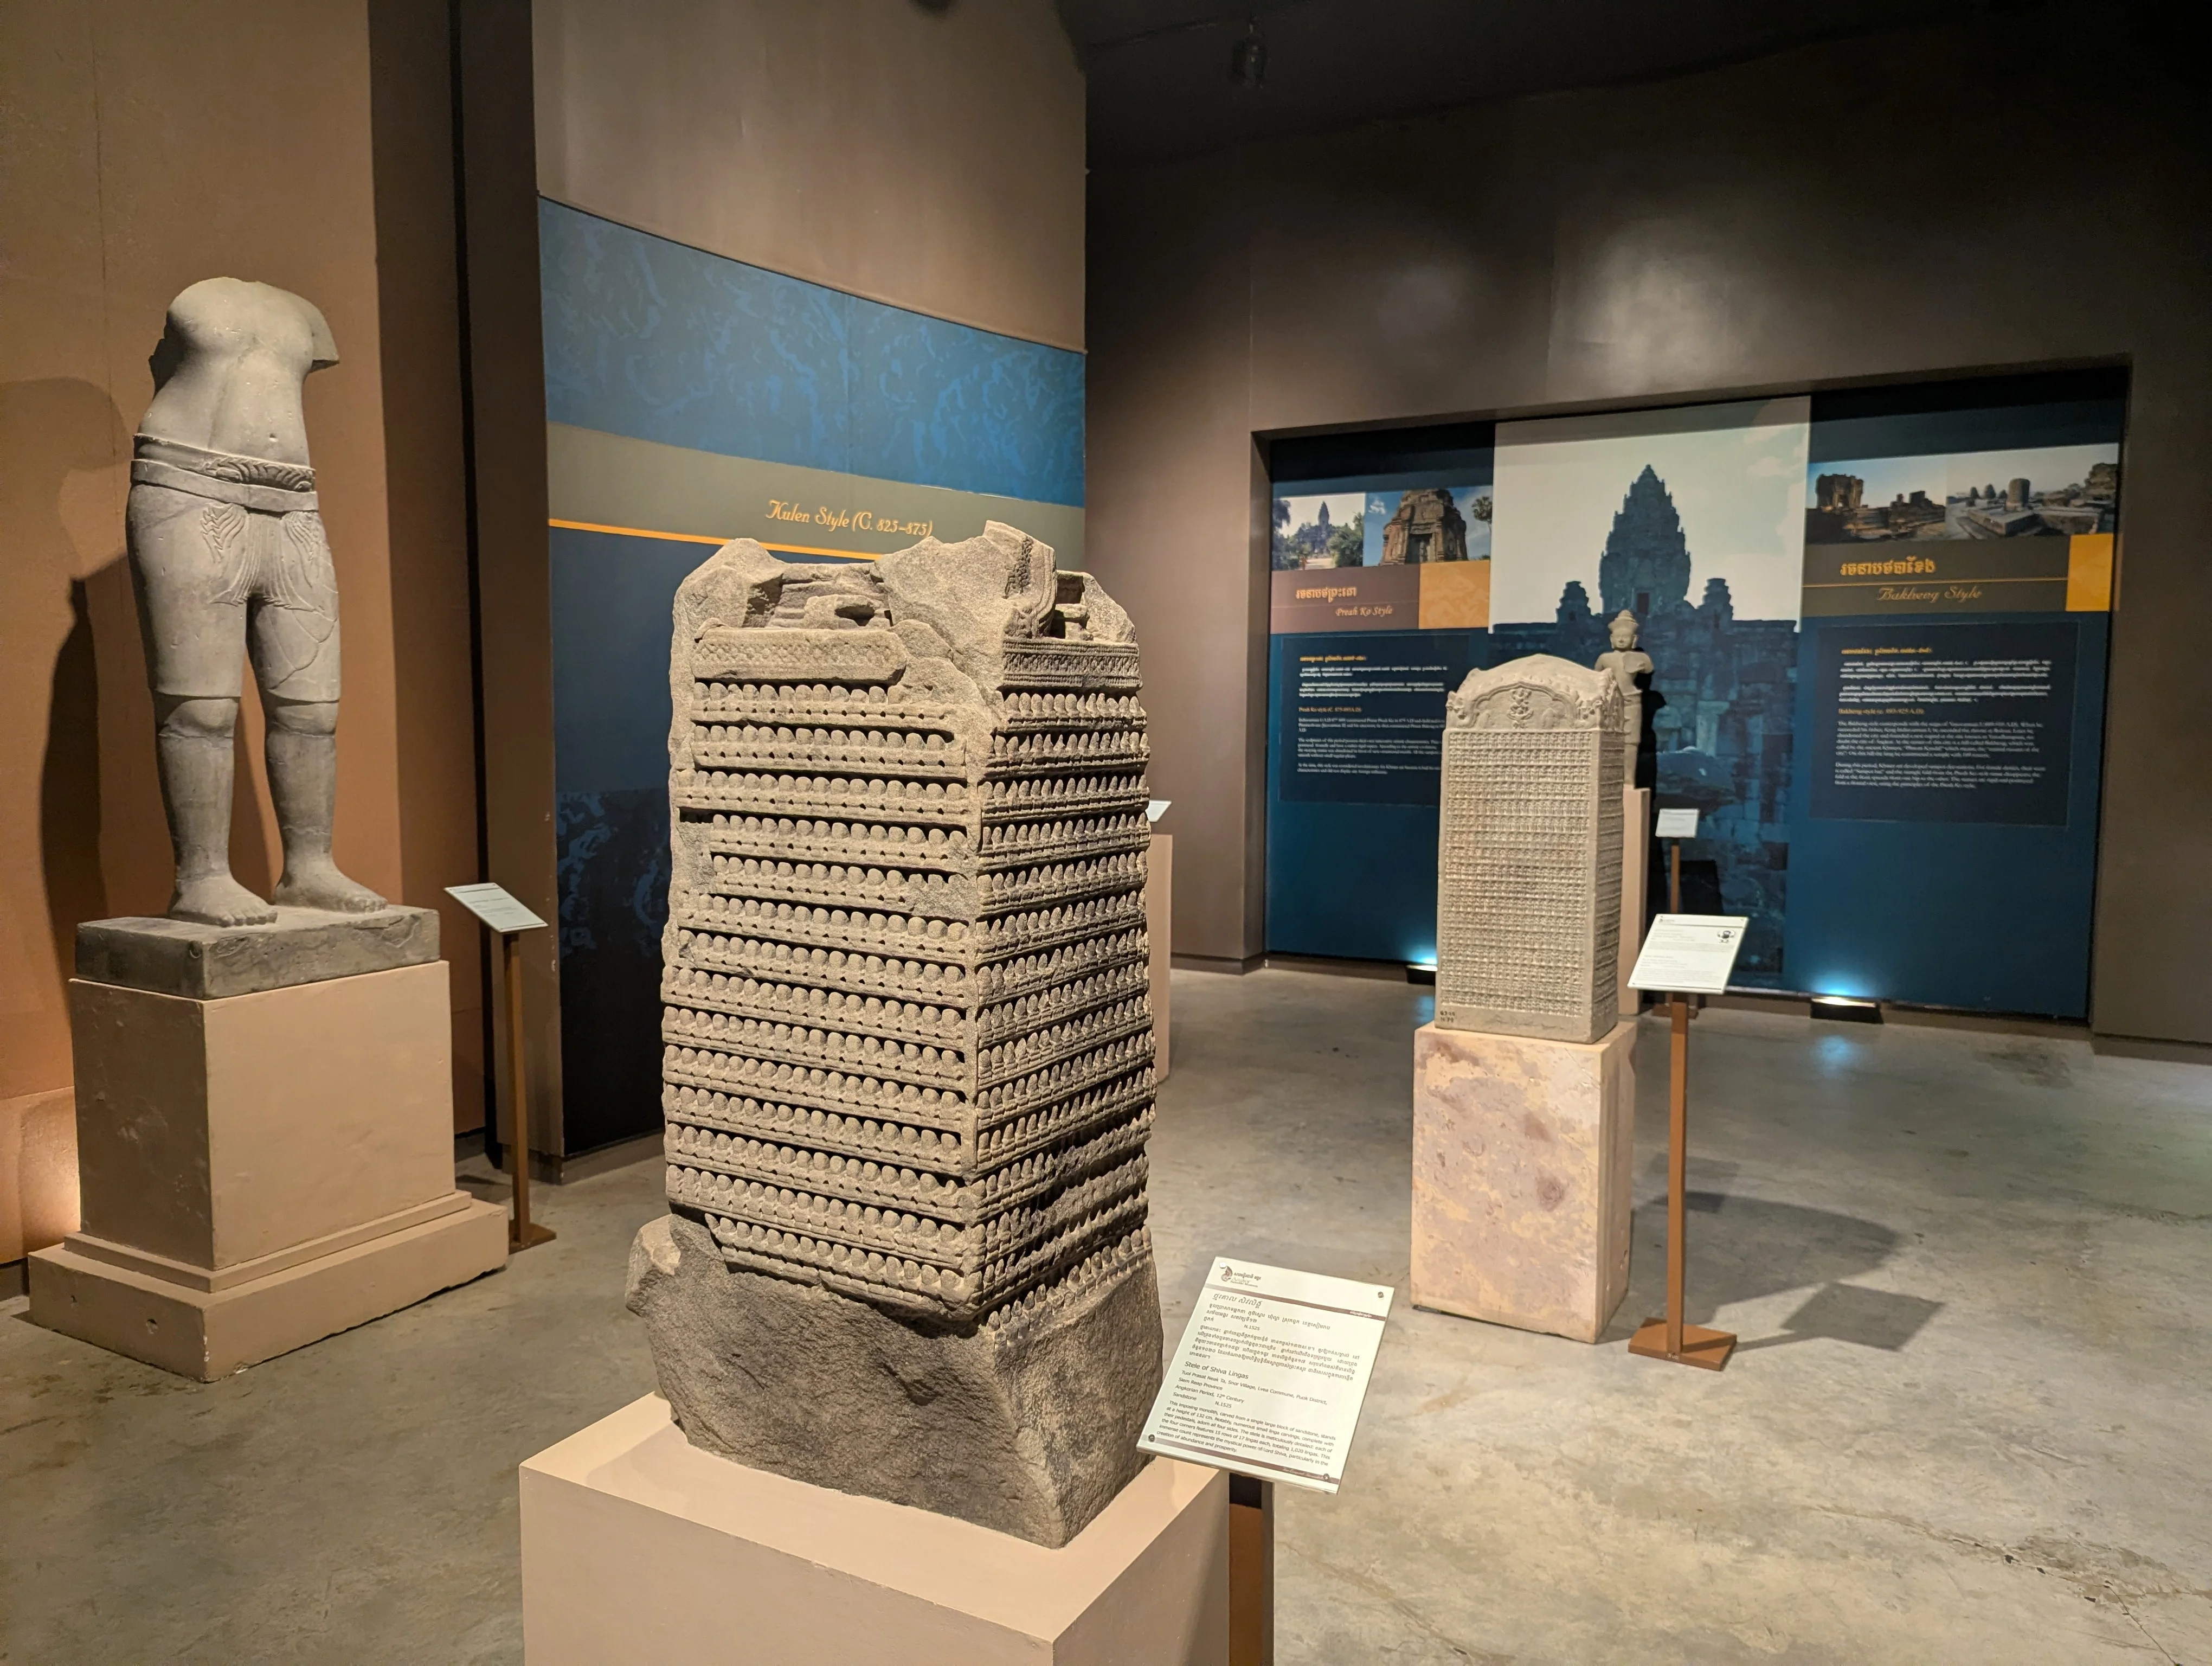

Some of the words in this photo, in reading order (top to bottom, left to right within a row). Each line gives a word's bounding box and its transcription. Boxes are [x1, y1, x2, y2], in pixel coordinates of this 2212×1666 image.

[766, 499, 810, 523] Kulen
[814, 507, 850, 532] Style
[852, 511, 872, 532] (C.
[1876, 586, 1940, 603] Bakheng
[1944, 586, 1982, 603] Style
[1335, 607, 1358, 616] Preah
[1360, 607, 1371, 617] Ko
[1372, 605, 1393, 617] Style
[1184, 1361, 1200, 1369] Stele
[1210, 1366, 1226, 1374] Shiva
[1228, 1370, 1248, 1379] Lingas
[1175, 1384, 1198, 1393] Angkorian
[1269, 1389, 1294, 1398] Commune,
[1172, 1392, 1197, 1400] Sandstone
[1178, 1402, 1198, 1411] imposing
[1198, 1407, 1218, 1415] monolith,
[1295, 1428, 1319, 1437] sandstone,
[1214, 1417, 1231, 1425] Notably,
[1174, 1415, 1195, 1423] pedestals,
[1265, 1436, 1293, 1445] meticulously
[1180, 1436, 1204, 1444] abundance
[1288, 1454, 1314, 1463] particularly
